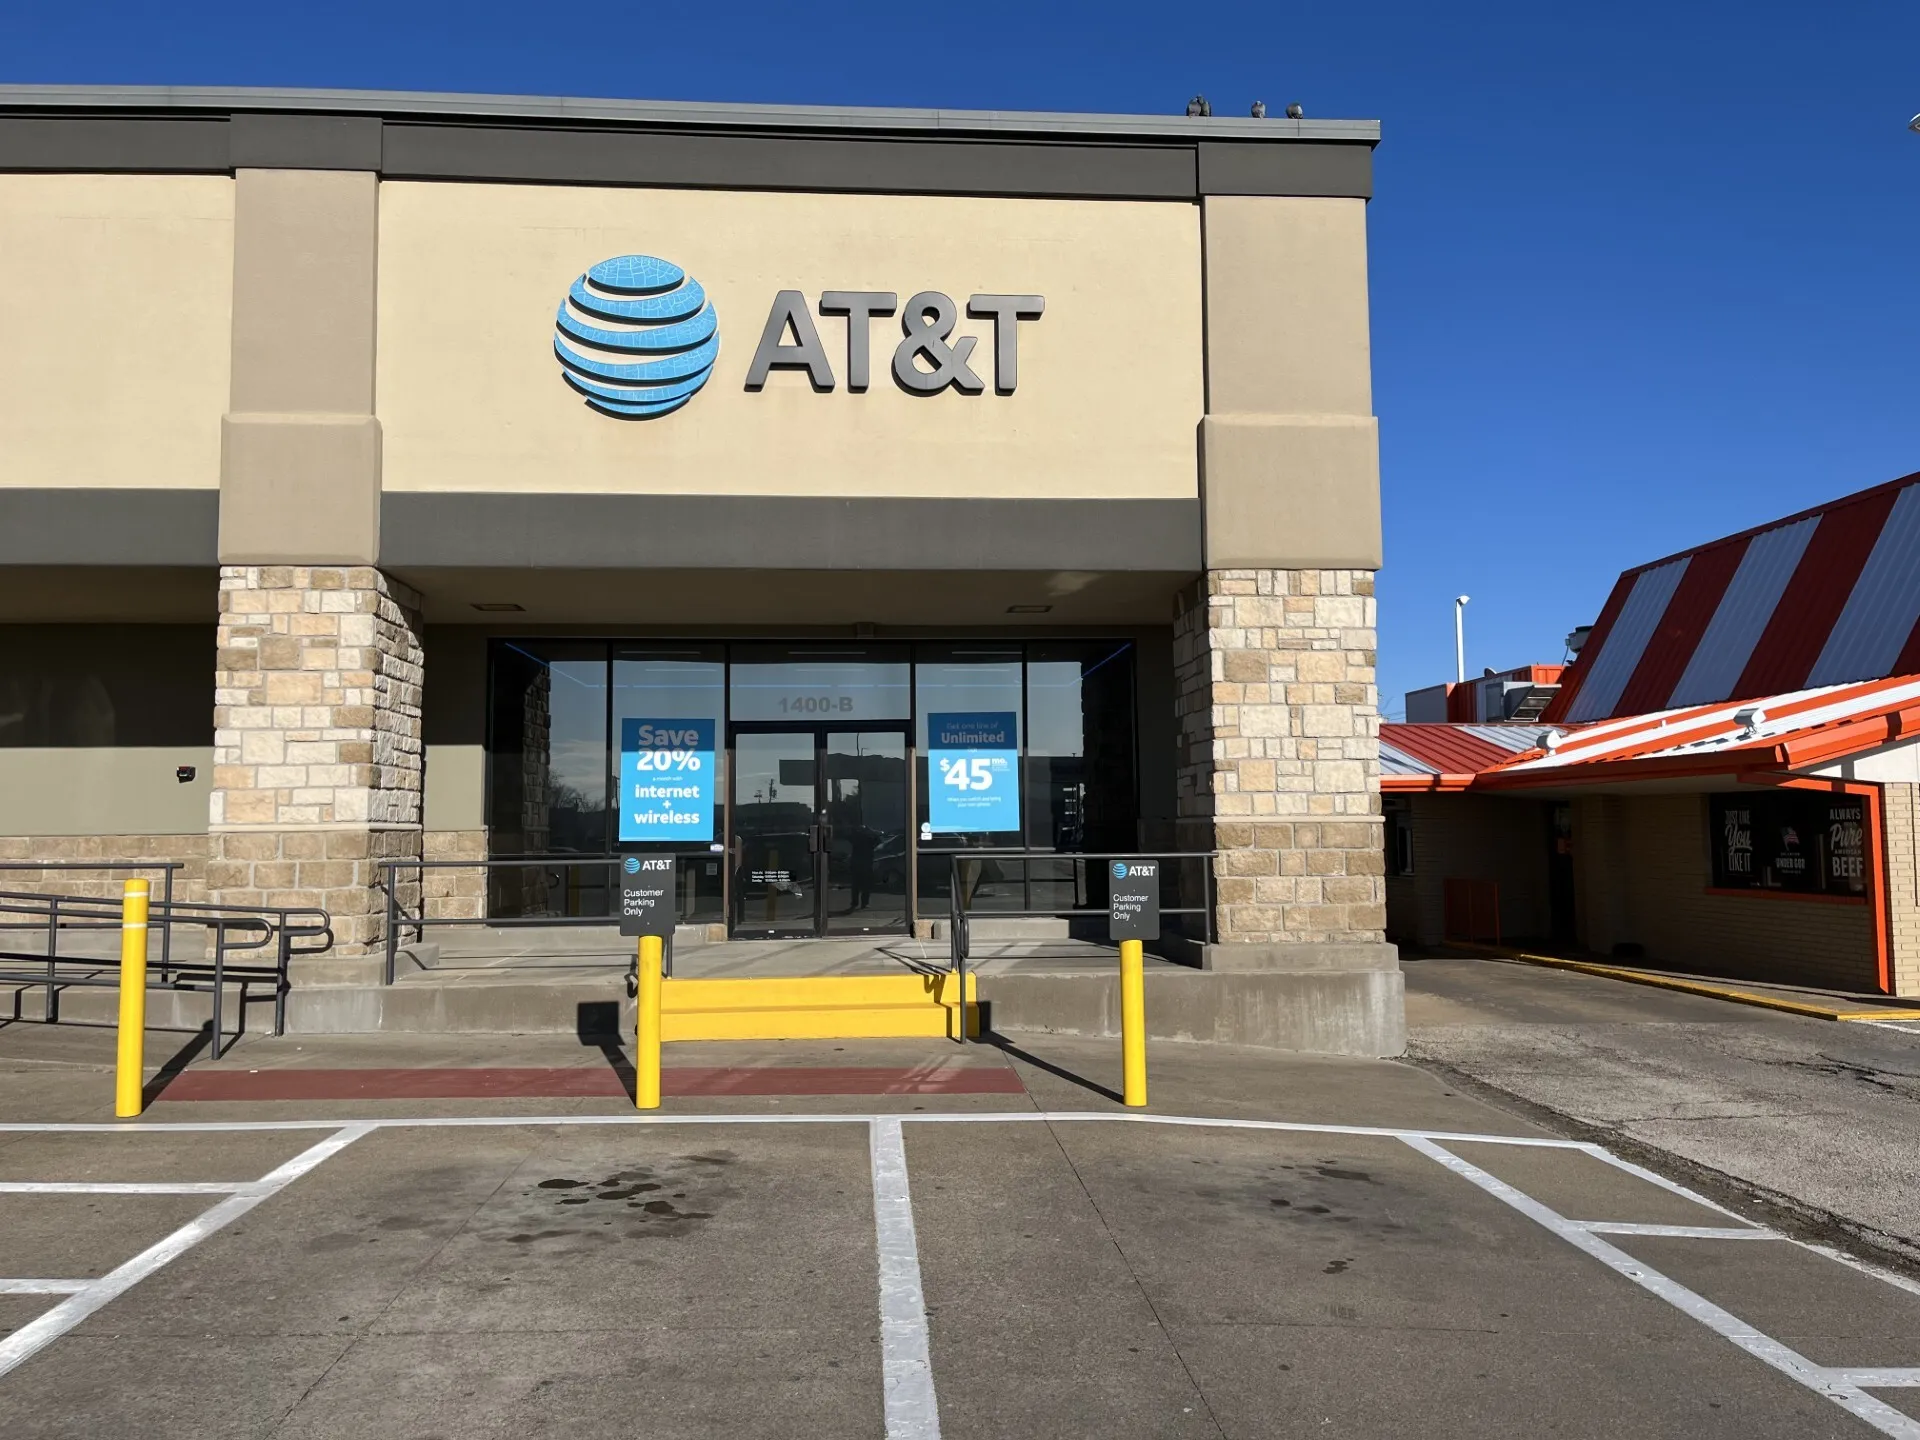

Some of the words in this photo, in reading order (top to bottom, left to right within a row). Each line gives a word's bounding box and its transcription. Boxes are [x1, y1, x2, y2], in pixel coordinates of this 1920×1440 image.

[744, 290, 1045, 396] AT&T
[777, 697, 854, 713] 1400-B
[638, 725, 699, 746] Save
[941, 731, 1005, 744] Unlimited
[636, 748, 701, 771] 20%
[635, 784, 700, 798] internet
[662, 800, 672, 809] +
[634, 810, 700, 824] wireless
[1829, 808, 1861, 820] ALWAYS
[1724, 820, 1753, 855] You
[1829, 823, 1863, 850] Pure
[642, 860, 672, 871] AT&T
[1728, 852, 1743, 872] LIKE
[1743, 852, 1751, 872] IT
[1775, 857, 1793, 869] UNDER
[1832, 856, 1863, 877] BEEF
[1128, 866, 1155, 876] AT&T
[624, 889, 664, 897] Customer
[1113, 894, 1149, 902] Customer
[624, 899, 655, 907] Parking
[1113, 903, 1141, 912] Parking
[624, 907, 643, 917] Only
[1113, 912, 1130, 921] Only
